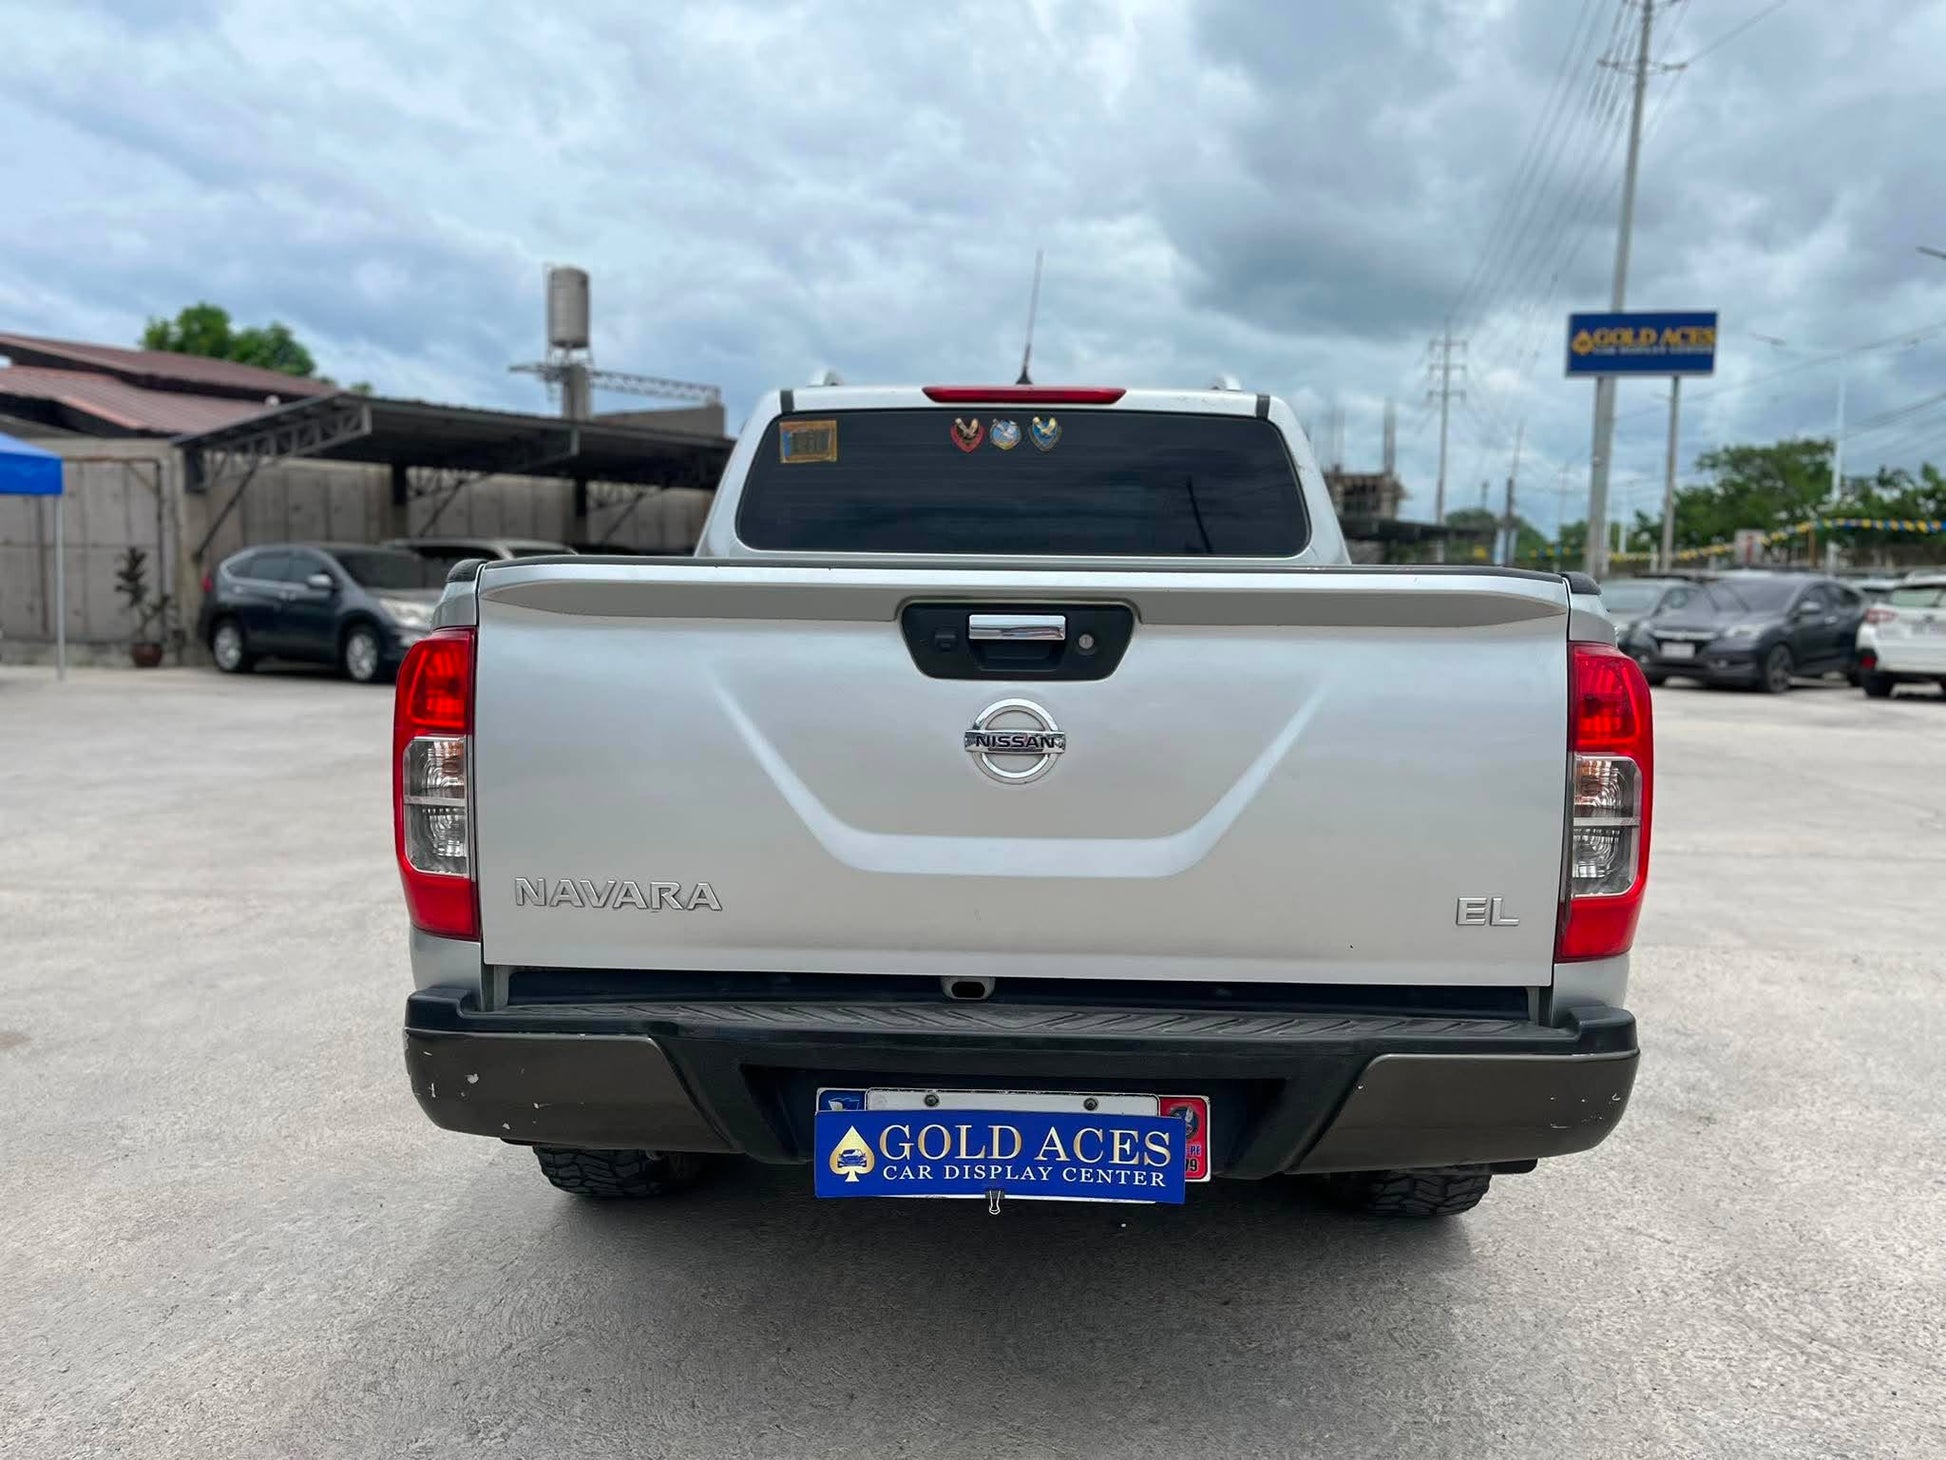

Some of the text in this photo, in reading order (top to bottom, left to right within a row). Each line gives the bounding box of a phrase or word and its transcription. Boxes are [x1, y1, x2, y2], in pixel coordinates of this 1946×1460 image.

[1593, 326, 1716, 346] GOLD ACES
[975, 735, 1055, 748] NISSAN
[514, 877, 723, 911] NAVARA
[1456, 897, 1520, 926] EL
[879, 1124, 1172, 1167] GOLD ACES
[883, 1165, 1166, 1187] CAR DISPLAY CENTER
